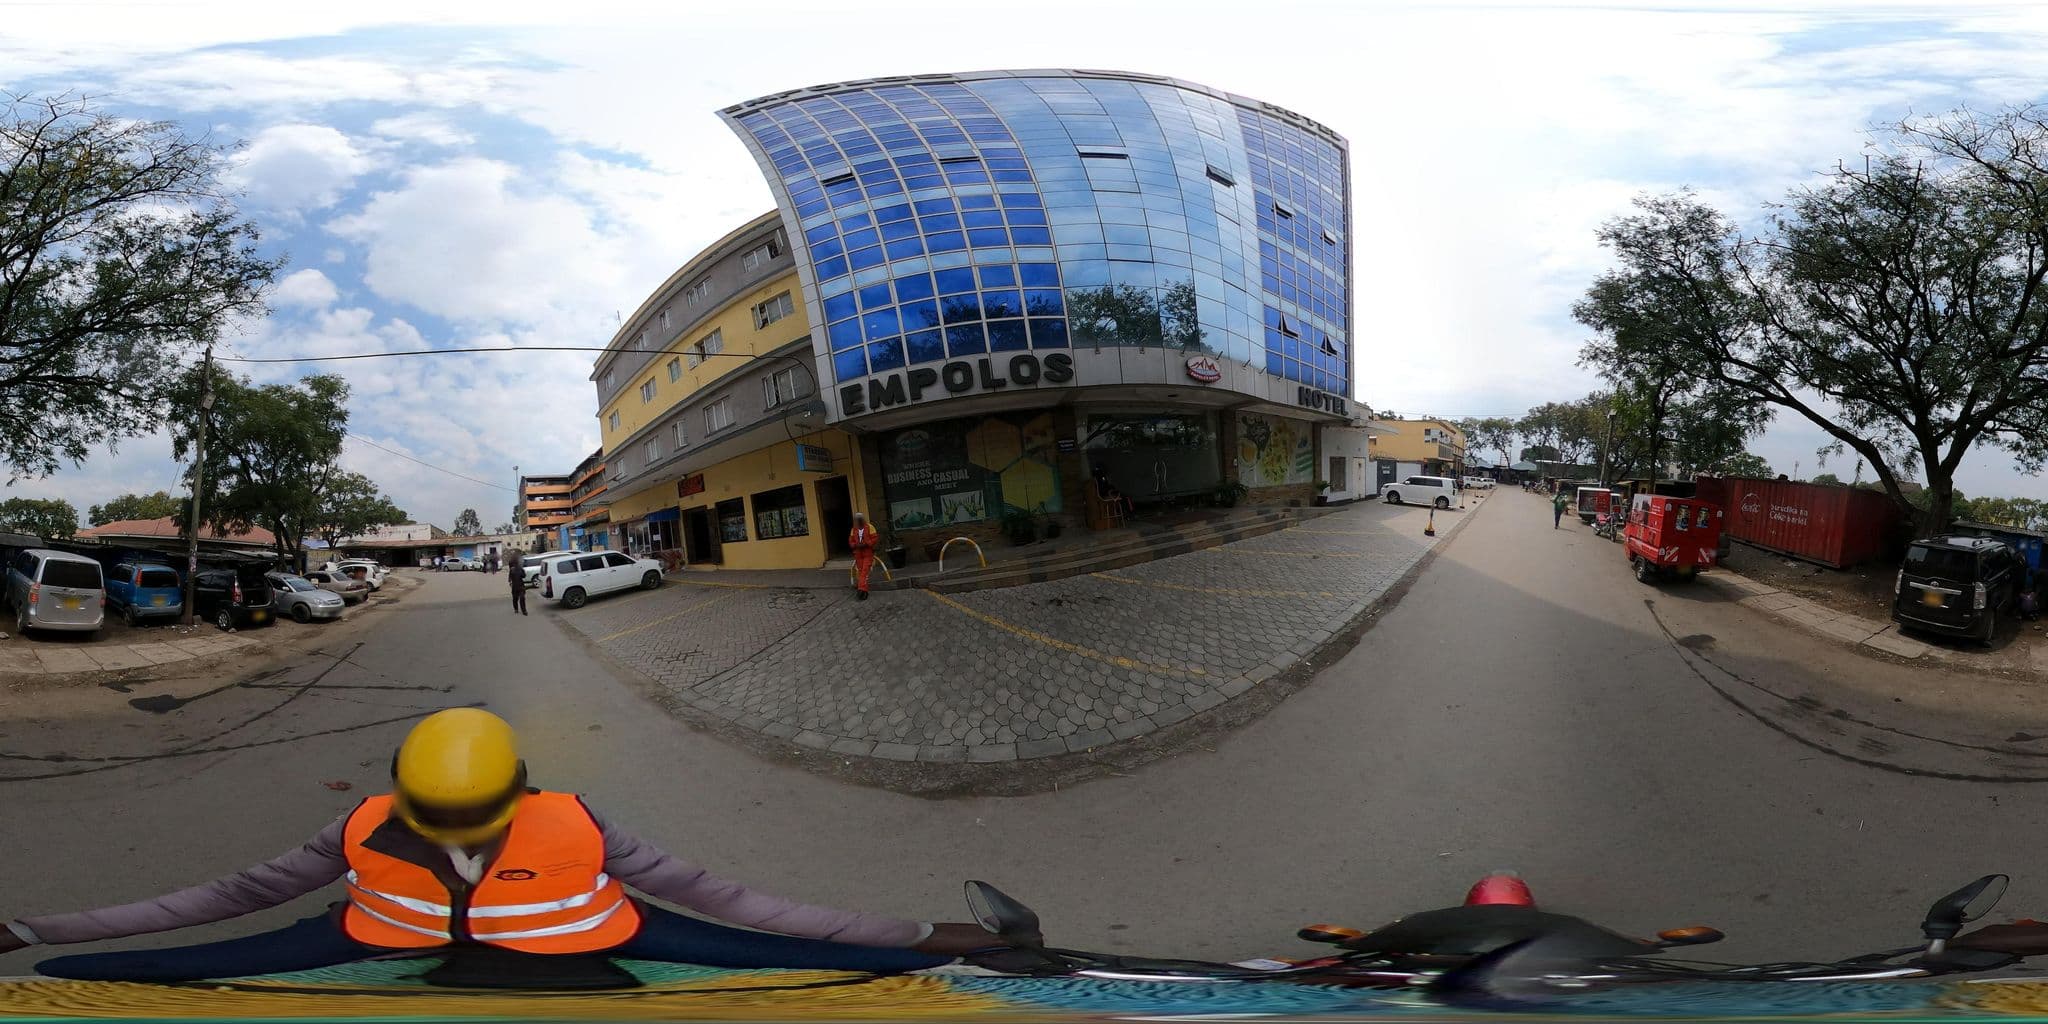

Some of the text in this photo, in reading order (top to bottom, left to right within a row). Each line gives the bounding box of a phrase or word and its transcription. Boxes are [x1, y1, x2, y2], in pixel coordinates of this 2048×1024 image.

[840, 353, 1074, 416] EMPOLOS
[1298, 386, 1349, 416] HOTEL
[887, 467, 970, 487] BUSINESS AND CASUAL
